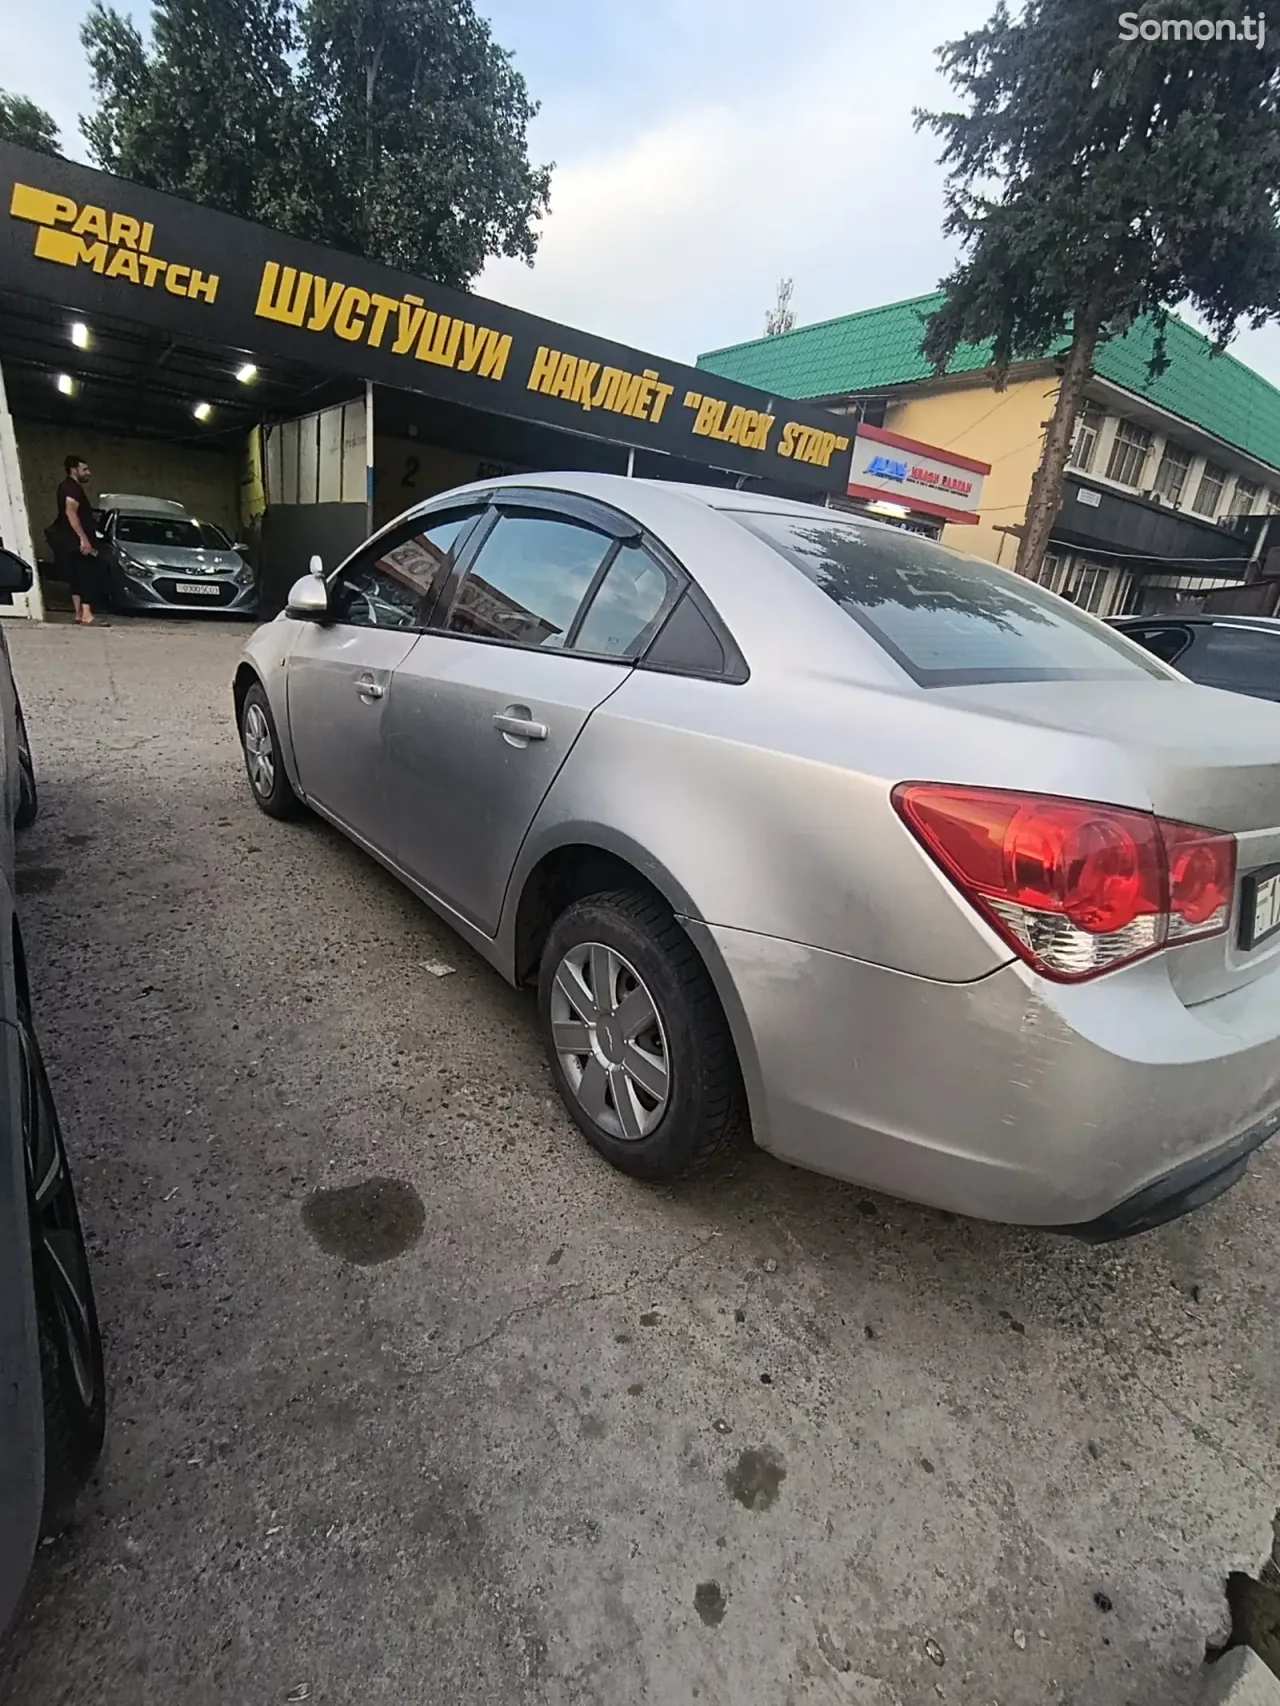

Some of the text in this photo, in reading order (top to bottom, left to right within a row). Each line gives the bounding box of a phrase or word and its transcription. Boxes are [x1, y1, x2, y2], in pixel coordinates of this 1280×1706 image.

[10, 183, 154, 253] PARI
[34, 226, 219, 304] MATCH
[683, 391, 775, 450] "BLACK
[777, 422, 849, 468] STAR"
[401, 457, 420, 487] 2
